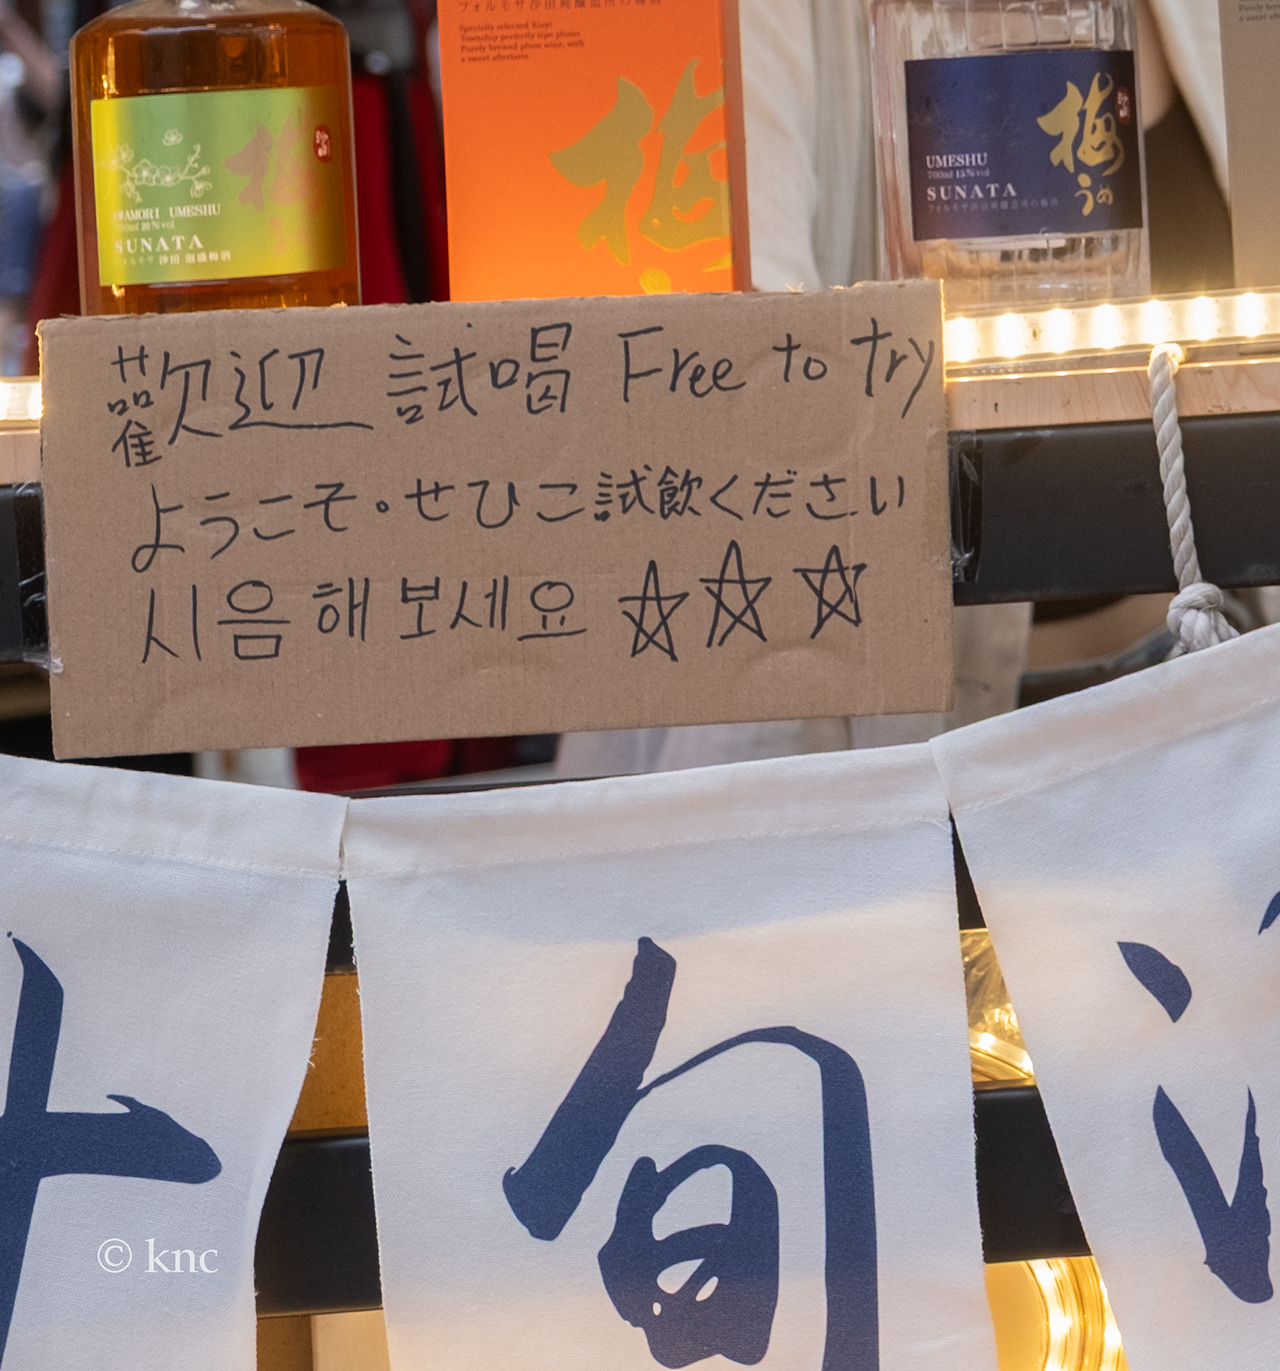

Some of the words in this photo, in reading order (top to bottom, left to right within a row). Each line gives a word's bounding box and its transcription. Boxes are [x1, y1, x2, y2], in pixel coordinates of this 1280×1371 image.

[1036, 71, 1125, 177] 梅
[926, 152, 988, 169] UMESHU
[927, 182, 1017, 202] SUNATA
[169, 203, 221, 219] UMESHU
[114, 234, 205, 254] SUNATA
[387, 322, 572, 424] 試喝
[617, 326, 746, 403] Free
[772, 333, 828, 382] to
[850, 317, 935, 419] try
